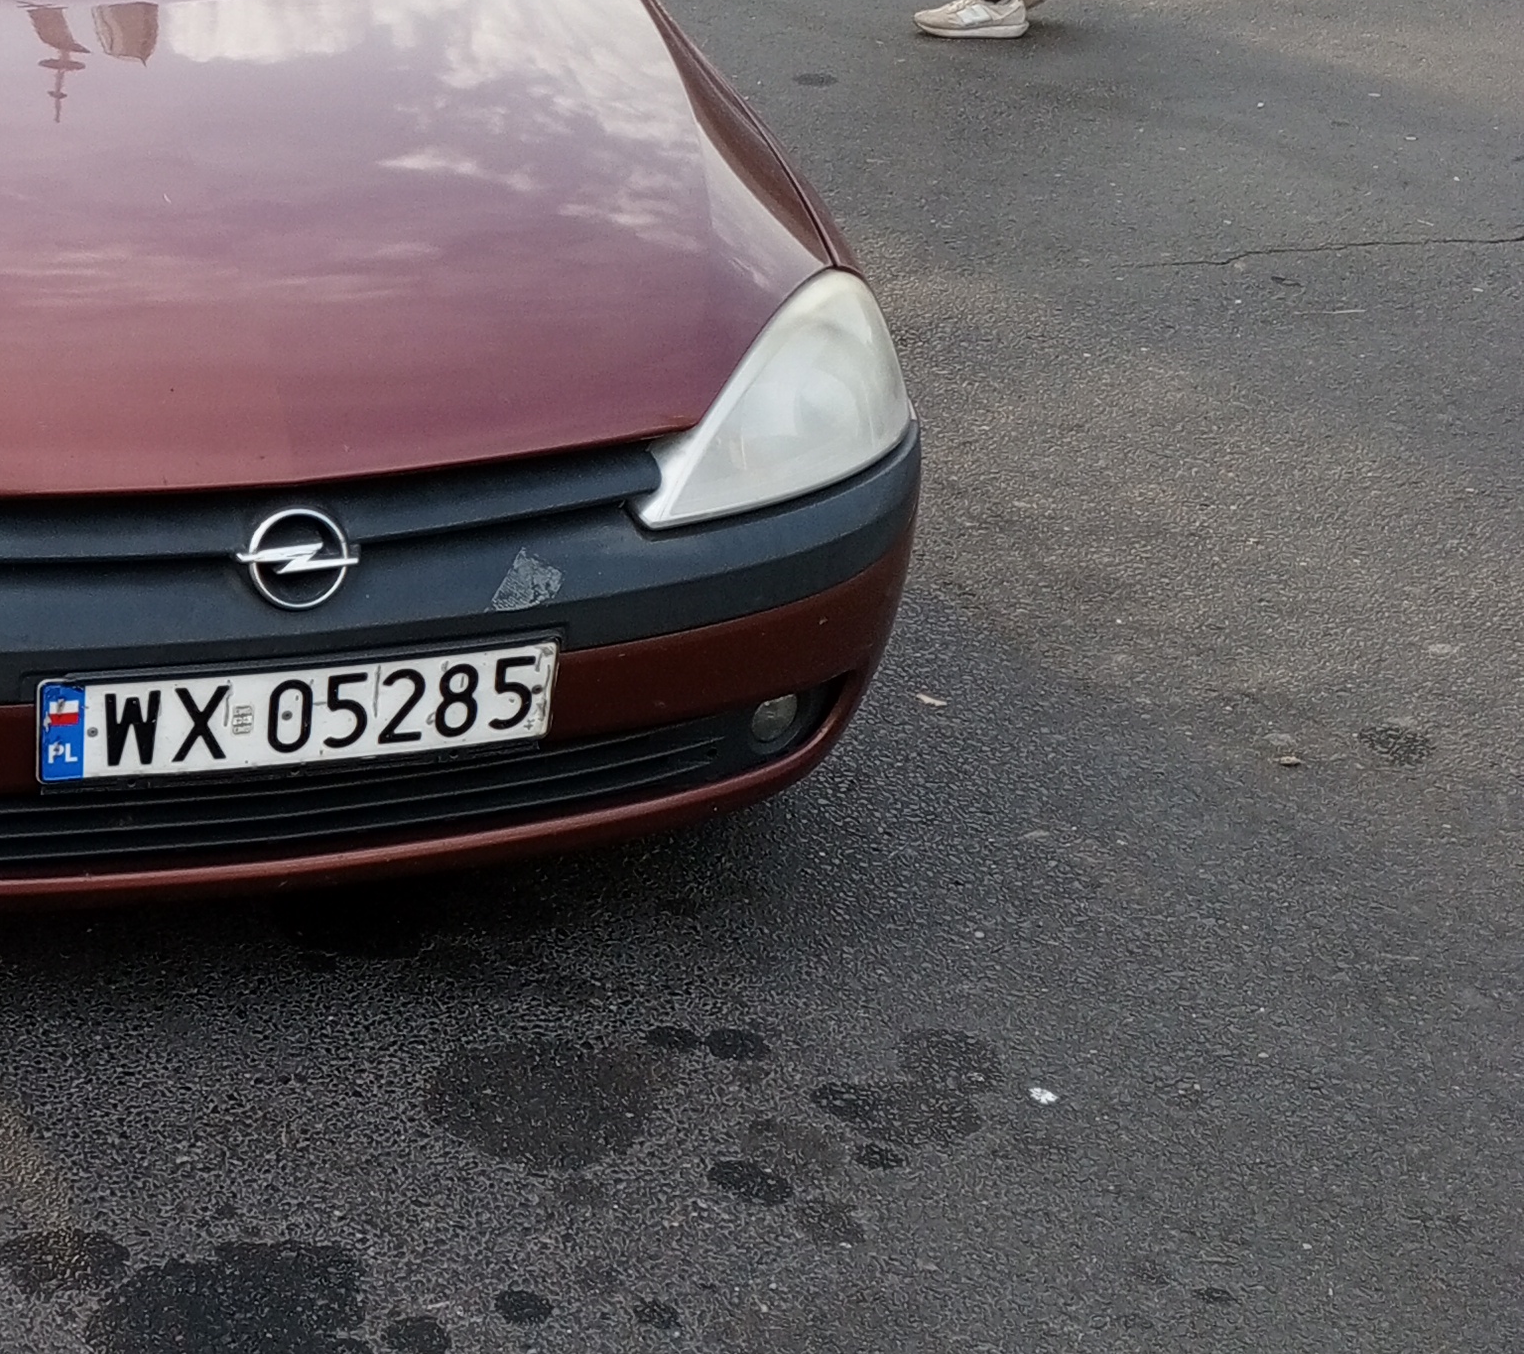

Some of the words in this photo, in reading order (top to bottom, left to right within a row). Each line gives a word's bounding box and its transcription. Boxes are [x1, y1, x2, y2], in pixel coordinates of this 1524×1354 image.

[48, 743, 78, 764] PL
[104, 685, 230, 766] WX
[267, 656, 537, 753] 05285
